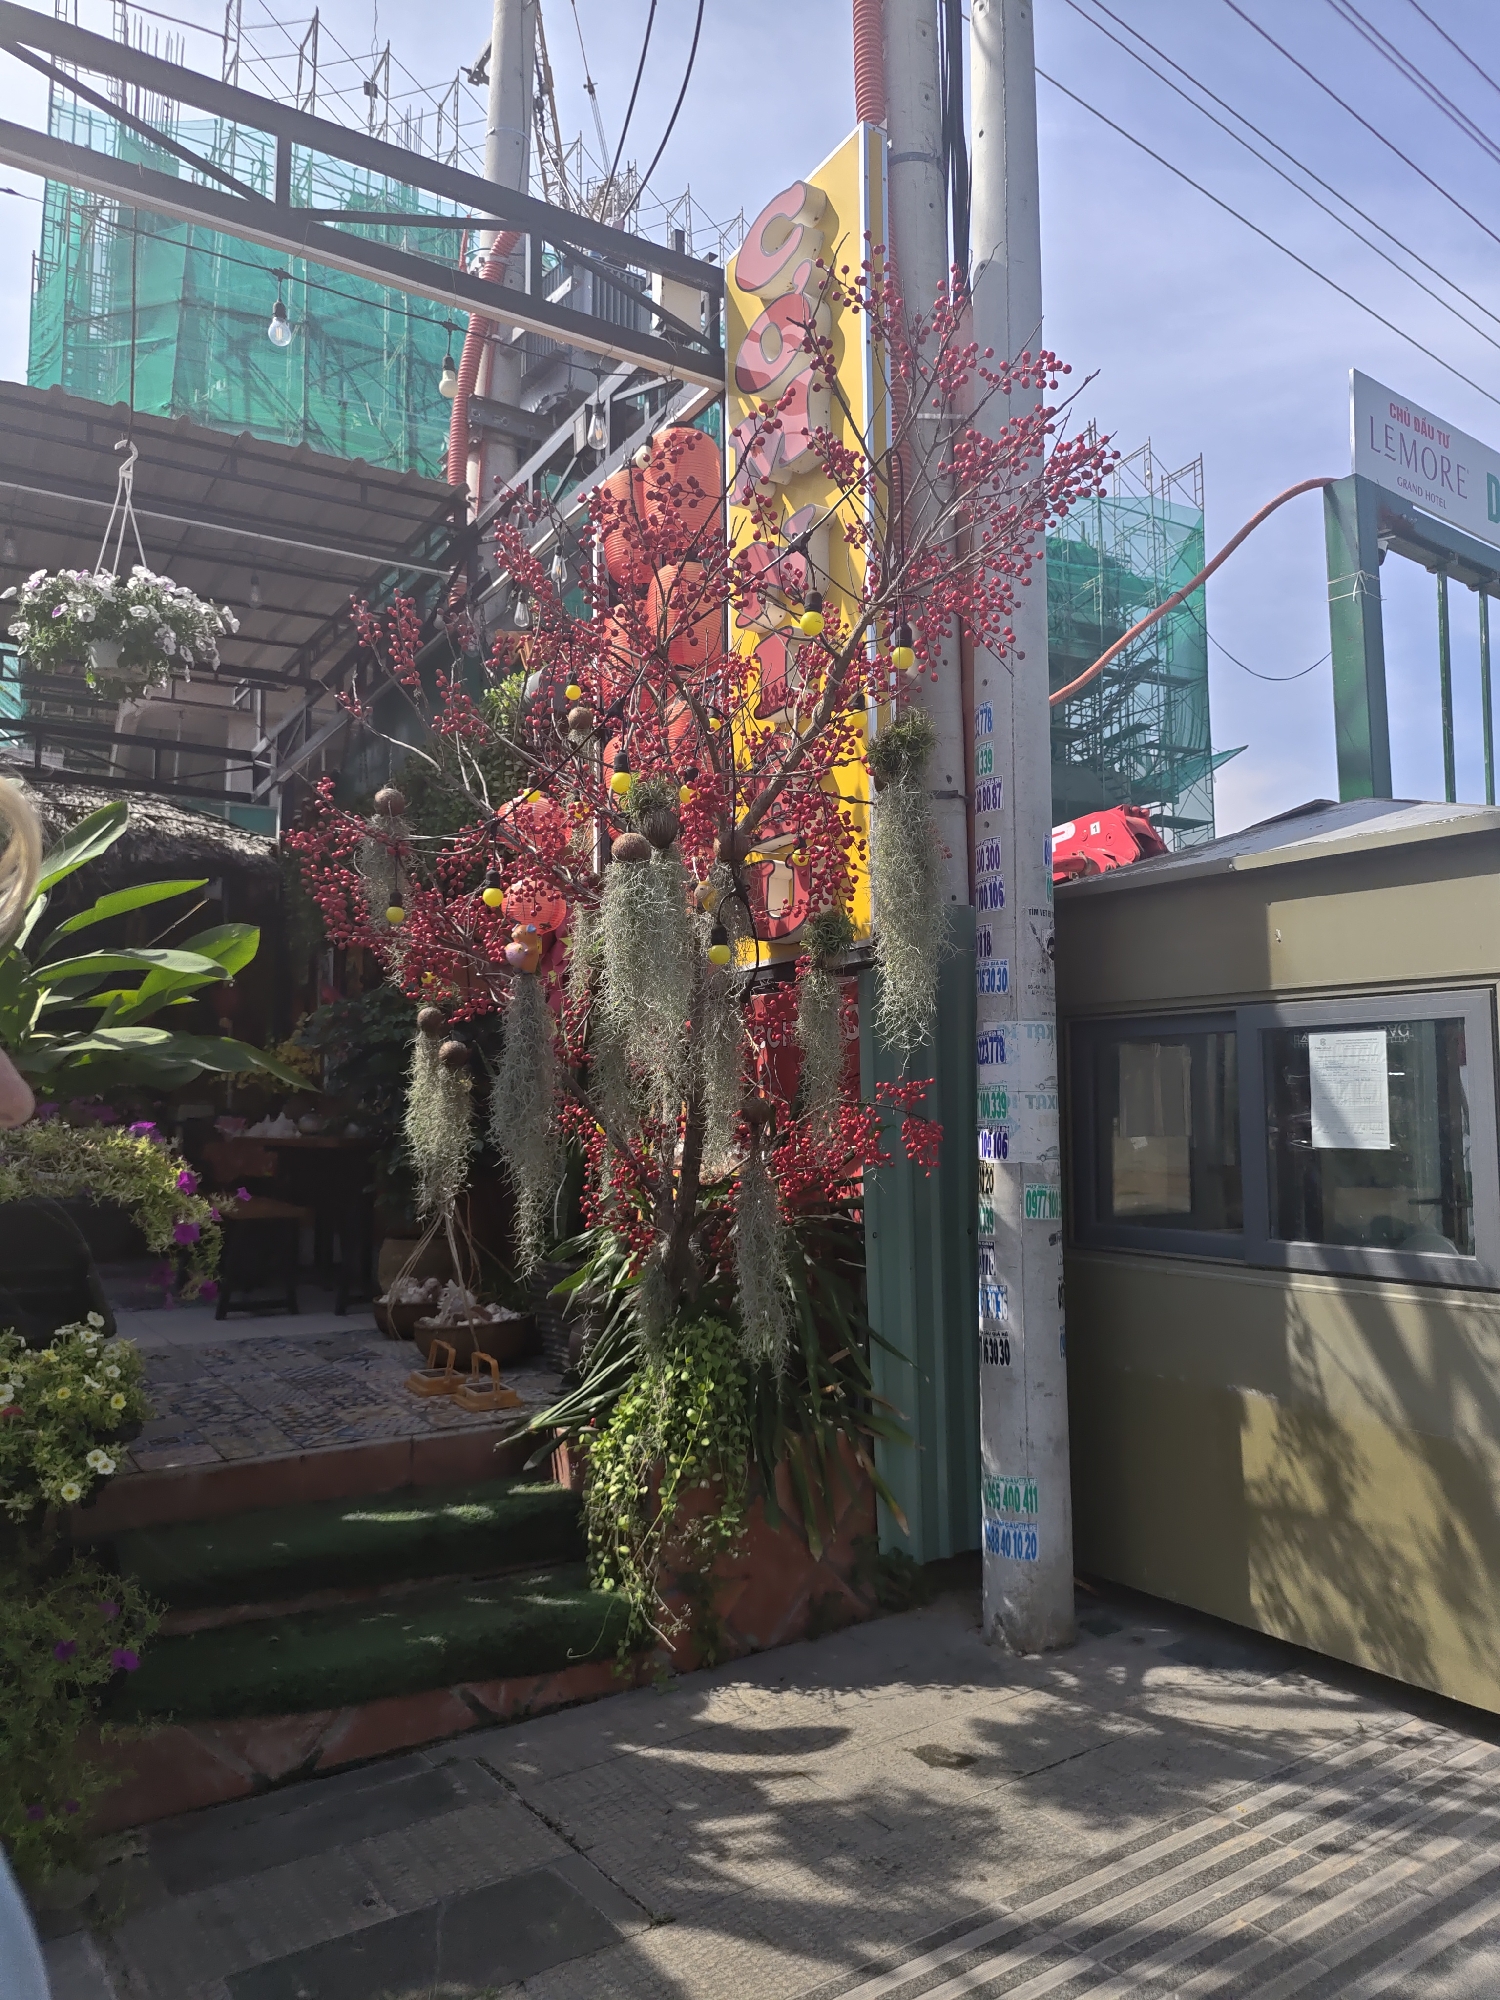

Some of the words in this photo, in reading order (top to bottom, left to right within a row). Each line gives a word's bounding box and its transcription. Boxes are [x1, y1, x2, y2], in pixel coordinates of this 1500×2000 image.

[1389, 402, 1411, 428] CHỦ
[1436, 429, 1451, 450] TƯ
[1396, 476, 1423, 497] GRAND
[1425, 489, 1447, 510] HOTEL
